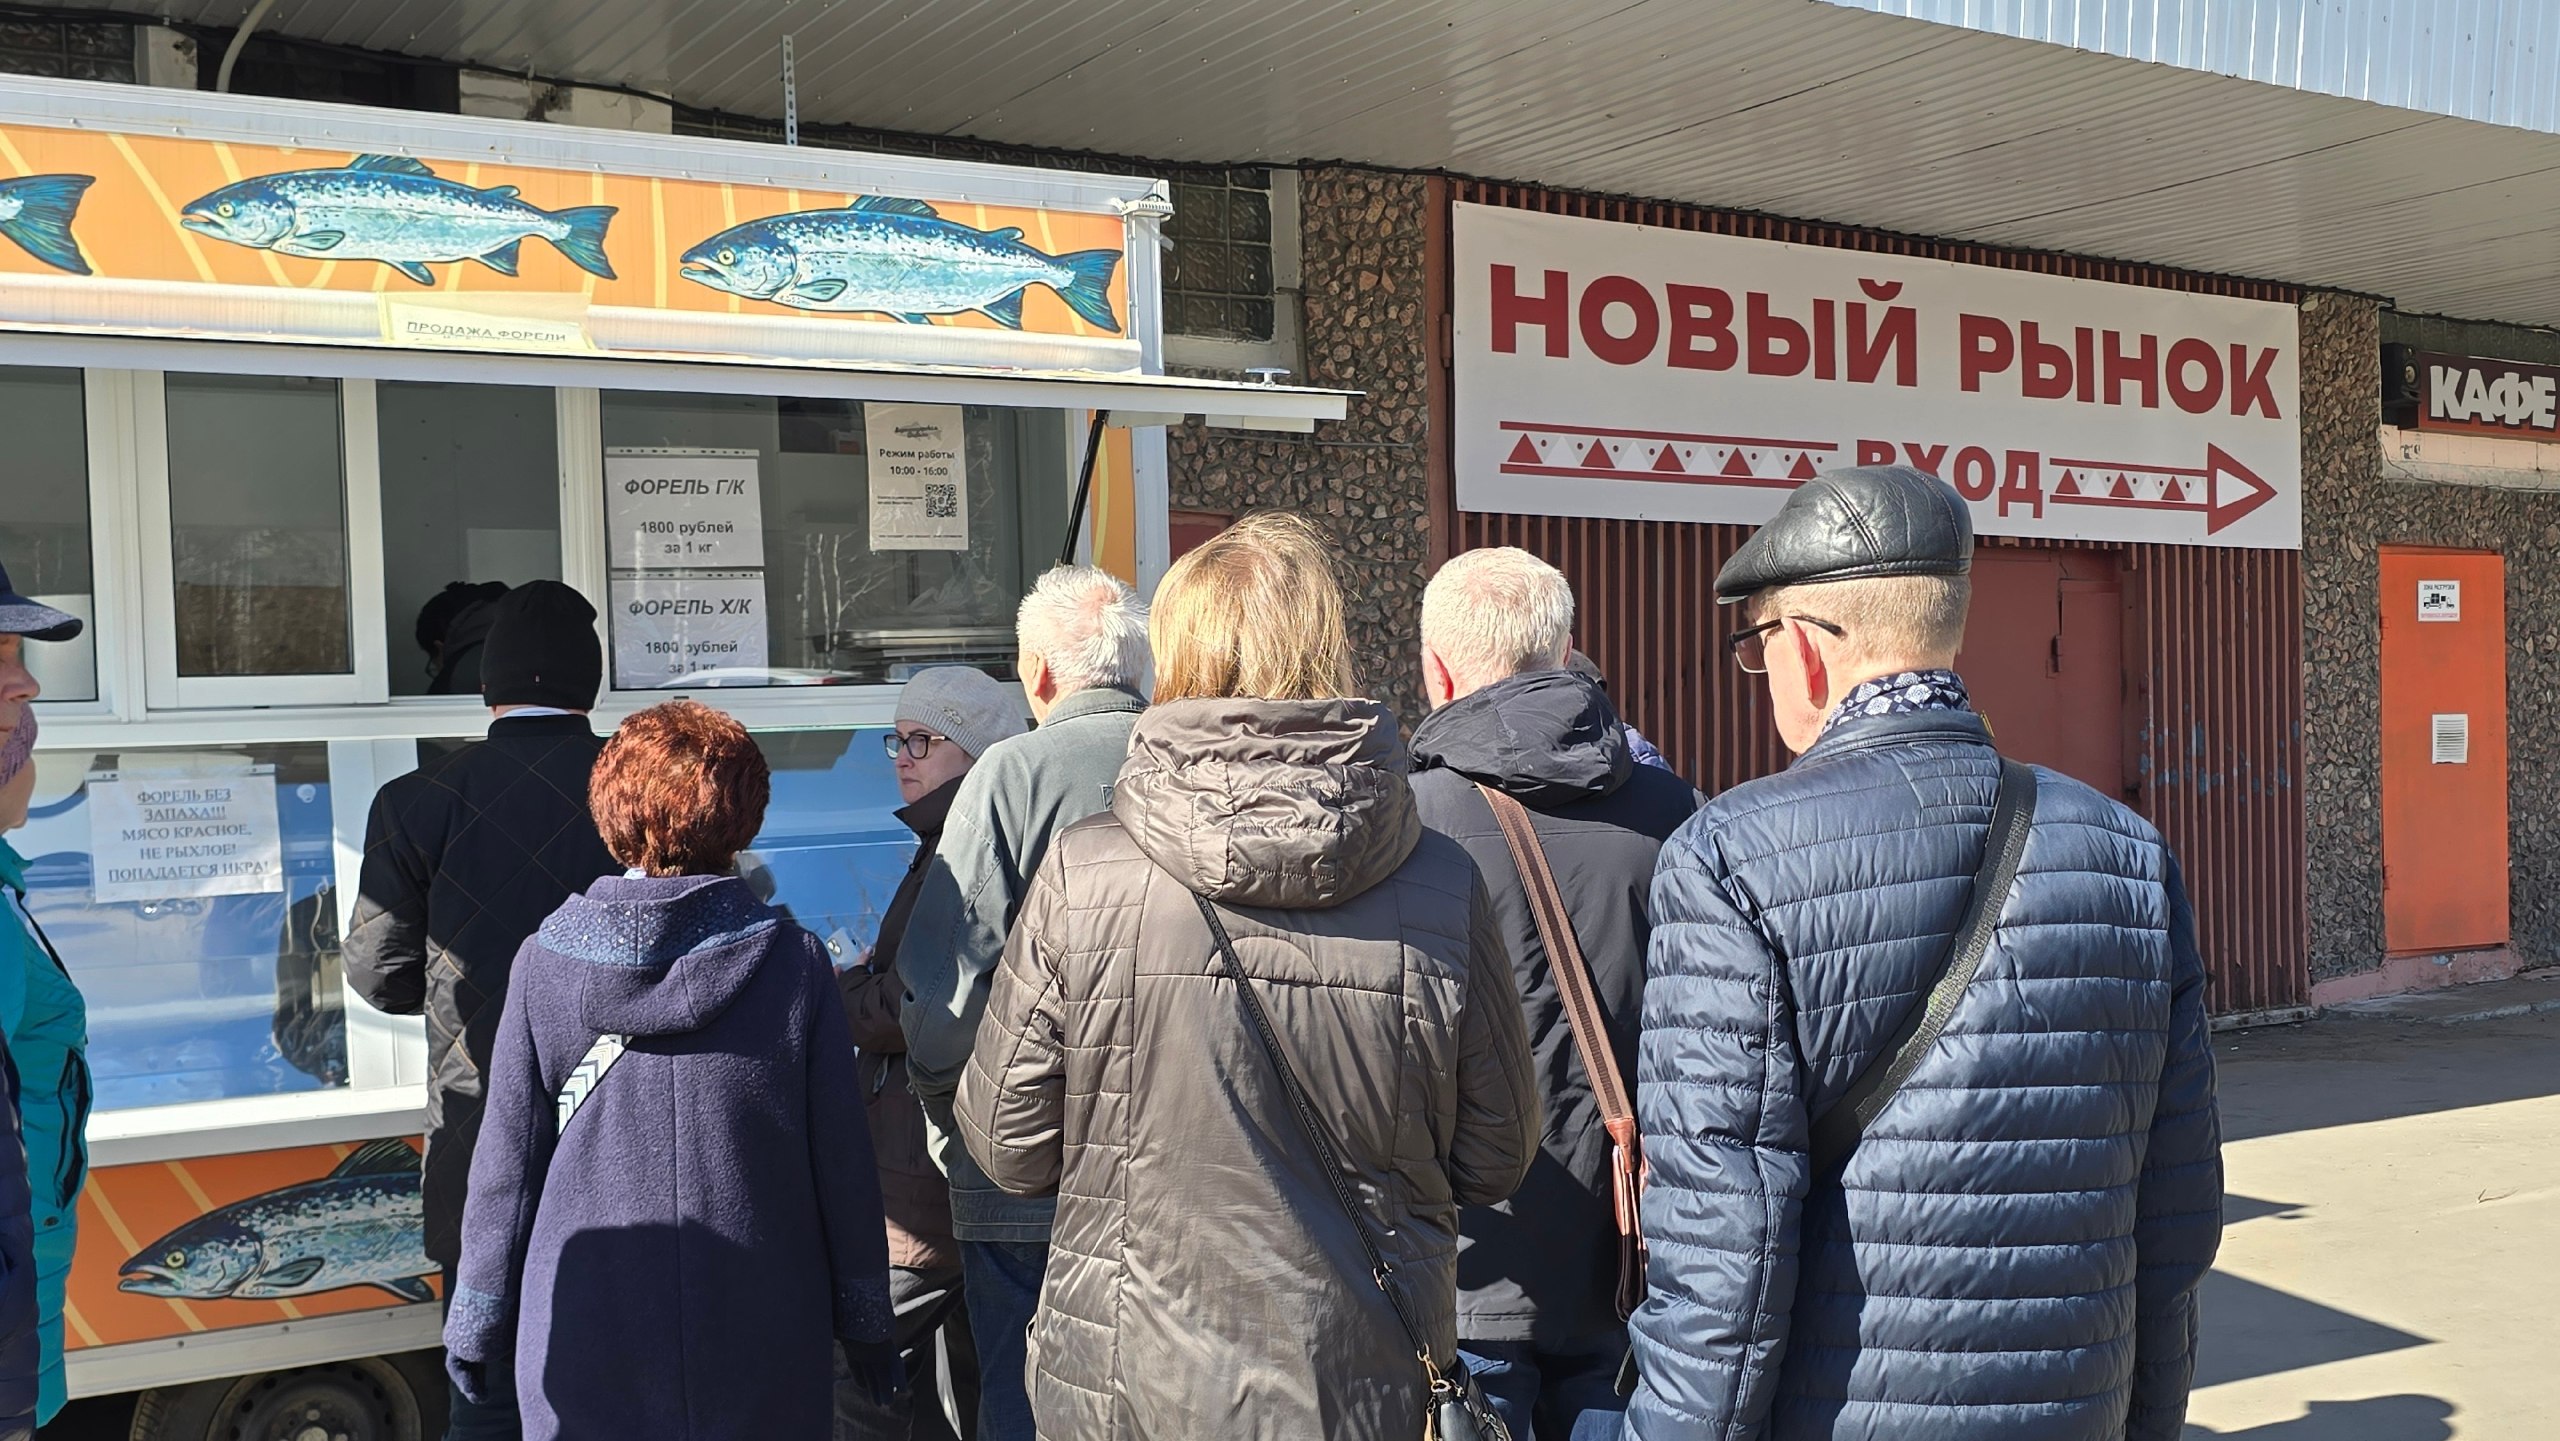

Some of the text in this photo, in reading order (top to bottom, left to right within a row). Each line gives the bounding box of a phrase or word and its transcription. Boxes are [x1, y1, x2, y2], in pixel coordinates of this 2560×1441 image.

[407, 321, 566, 341] ПРОДАЖА ФОРЕЛИ
[1490, 263, 2282, 419] НОВЫЙ РЫНОК
[2430, 365, 2556, 428] КАФЕ
[879, 448, 955, 460] Режим работы
[890, 466, 915, 475] 10:00
[923, 467, 948, 476] 16:00
[625, 479, 745, 495] ФОРЕЛЬ Г/К
[640, 521, 734, 536] 1800 рублей
[664, 541, 713, 553] за 1 кг
[628, 599, 752, 616] ФОРЕЛЬ Х/К
[645, 642, 679, 654] 1800
[669, 664, 684, 673] за
[690, 661, 697, 673] 1
[138, 788, 232, 804] ФОРЕЛЬ БЕЗ
[144, 806, 227, 822] ЗАПАХА!!!
[122, 828, 170, 841] МЯСО
[140, 844, 236, 860] НЕ РЫХЛОЕ!
[108, 861, 269, 882] ПОПАДАЕТСЯ ИКРА!
